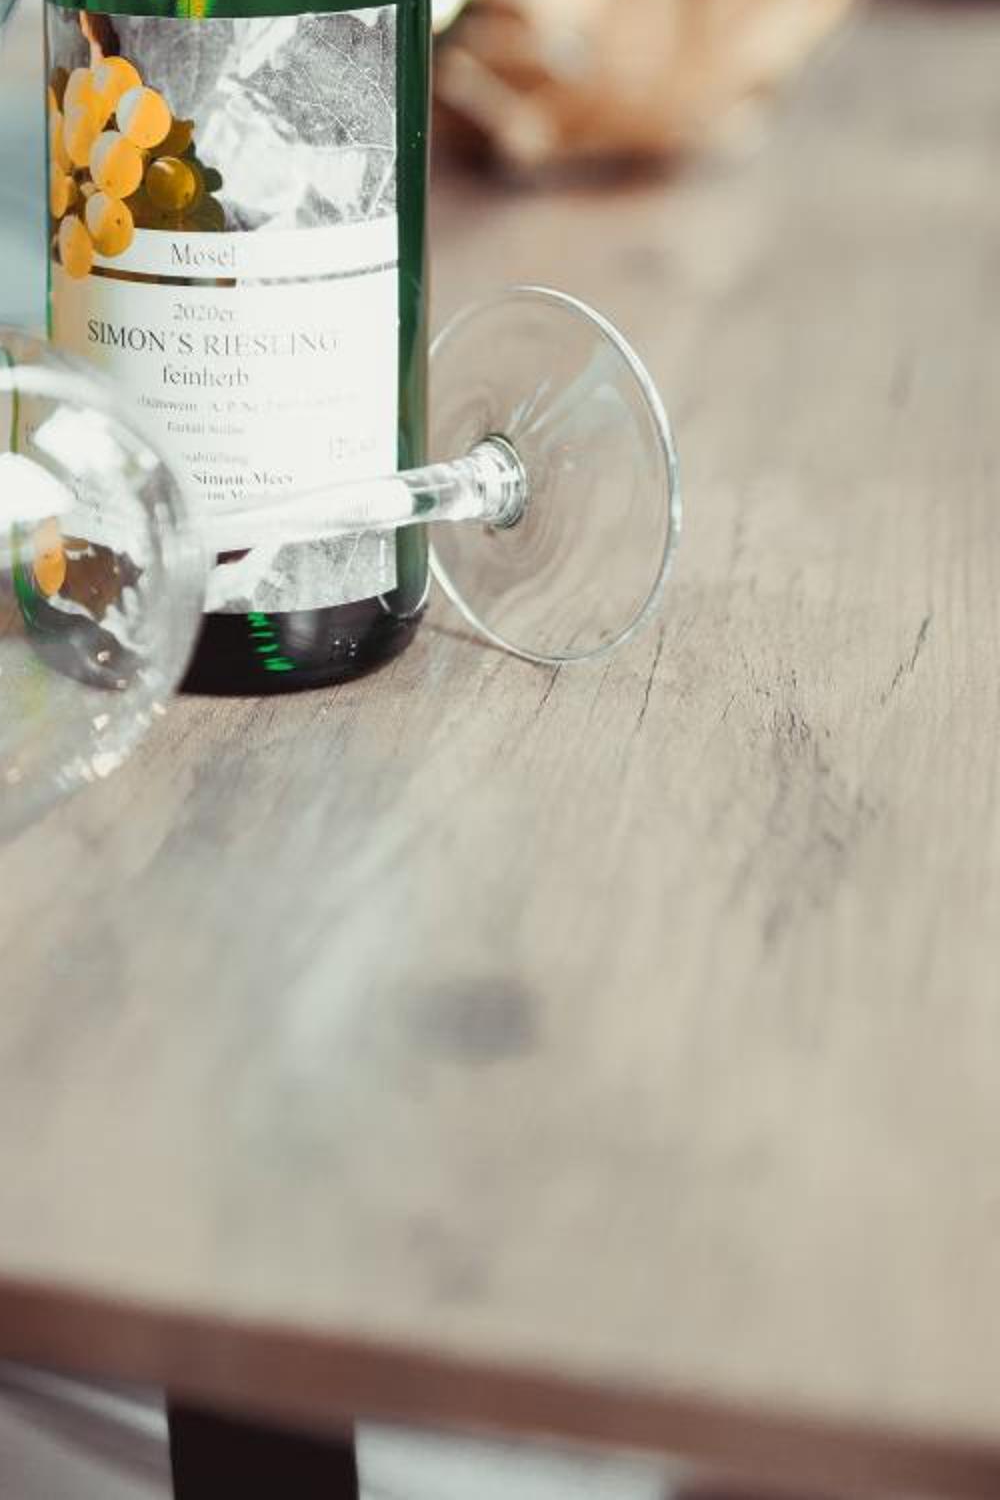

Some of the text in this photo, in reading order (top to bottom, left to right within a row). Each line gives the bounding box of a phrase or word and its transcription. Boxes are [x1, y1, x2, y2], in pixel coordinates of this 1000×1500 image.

[170, 242, 236, 267] Mosel
[203, 331, 339, 357] RIESLING
[161, 364, 250, 389] feinherb
